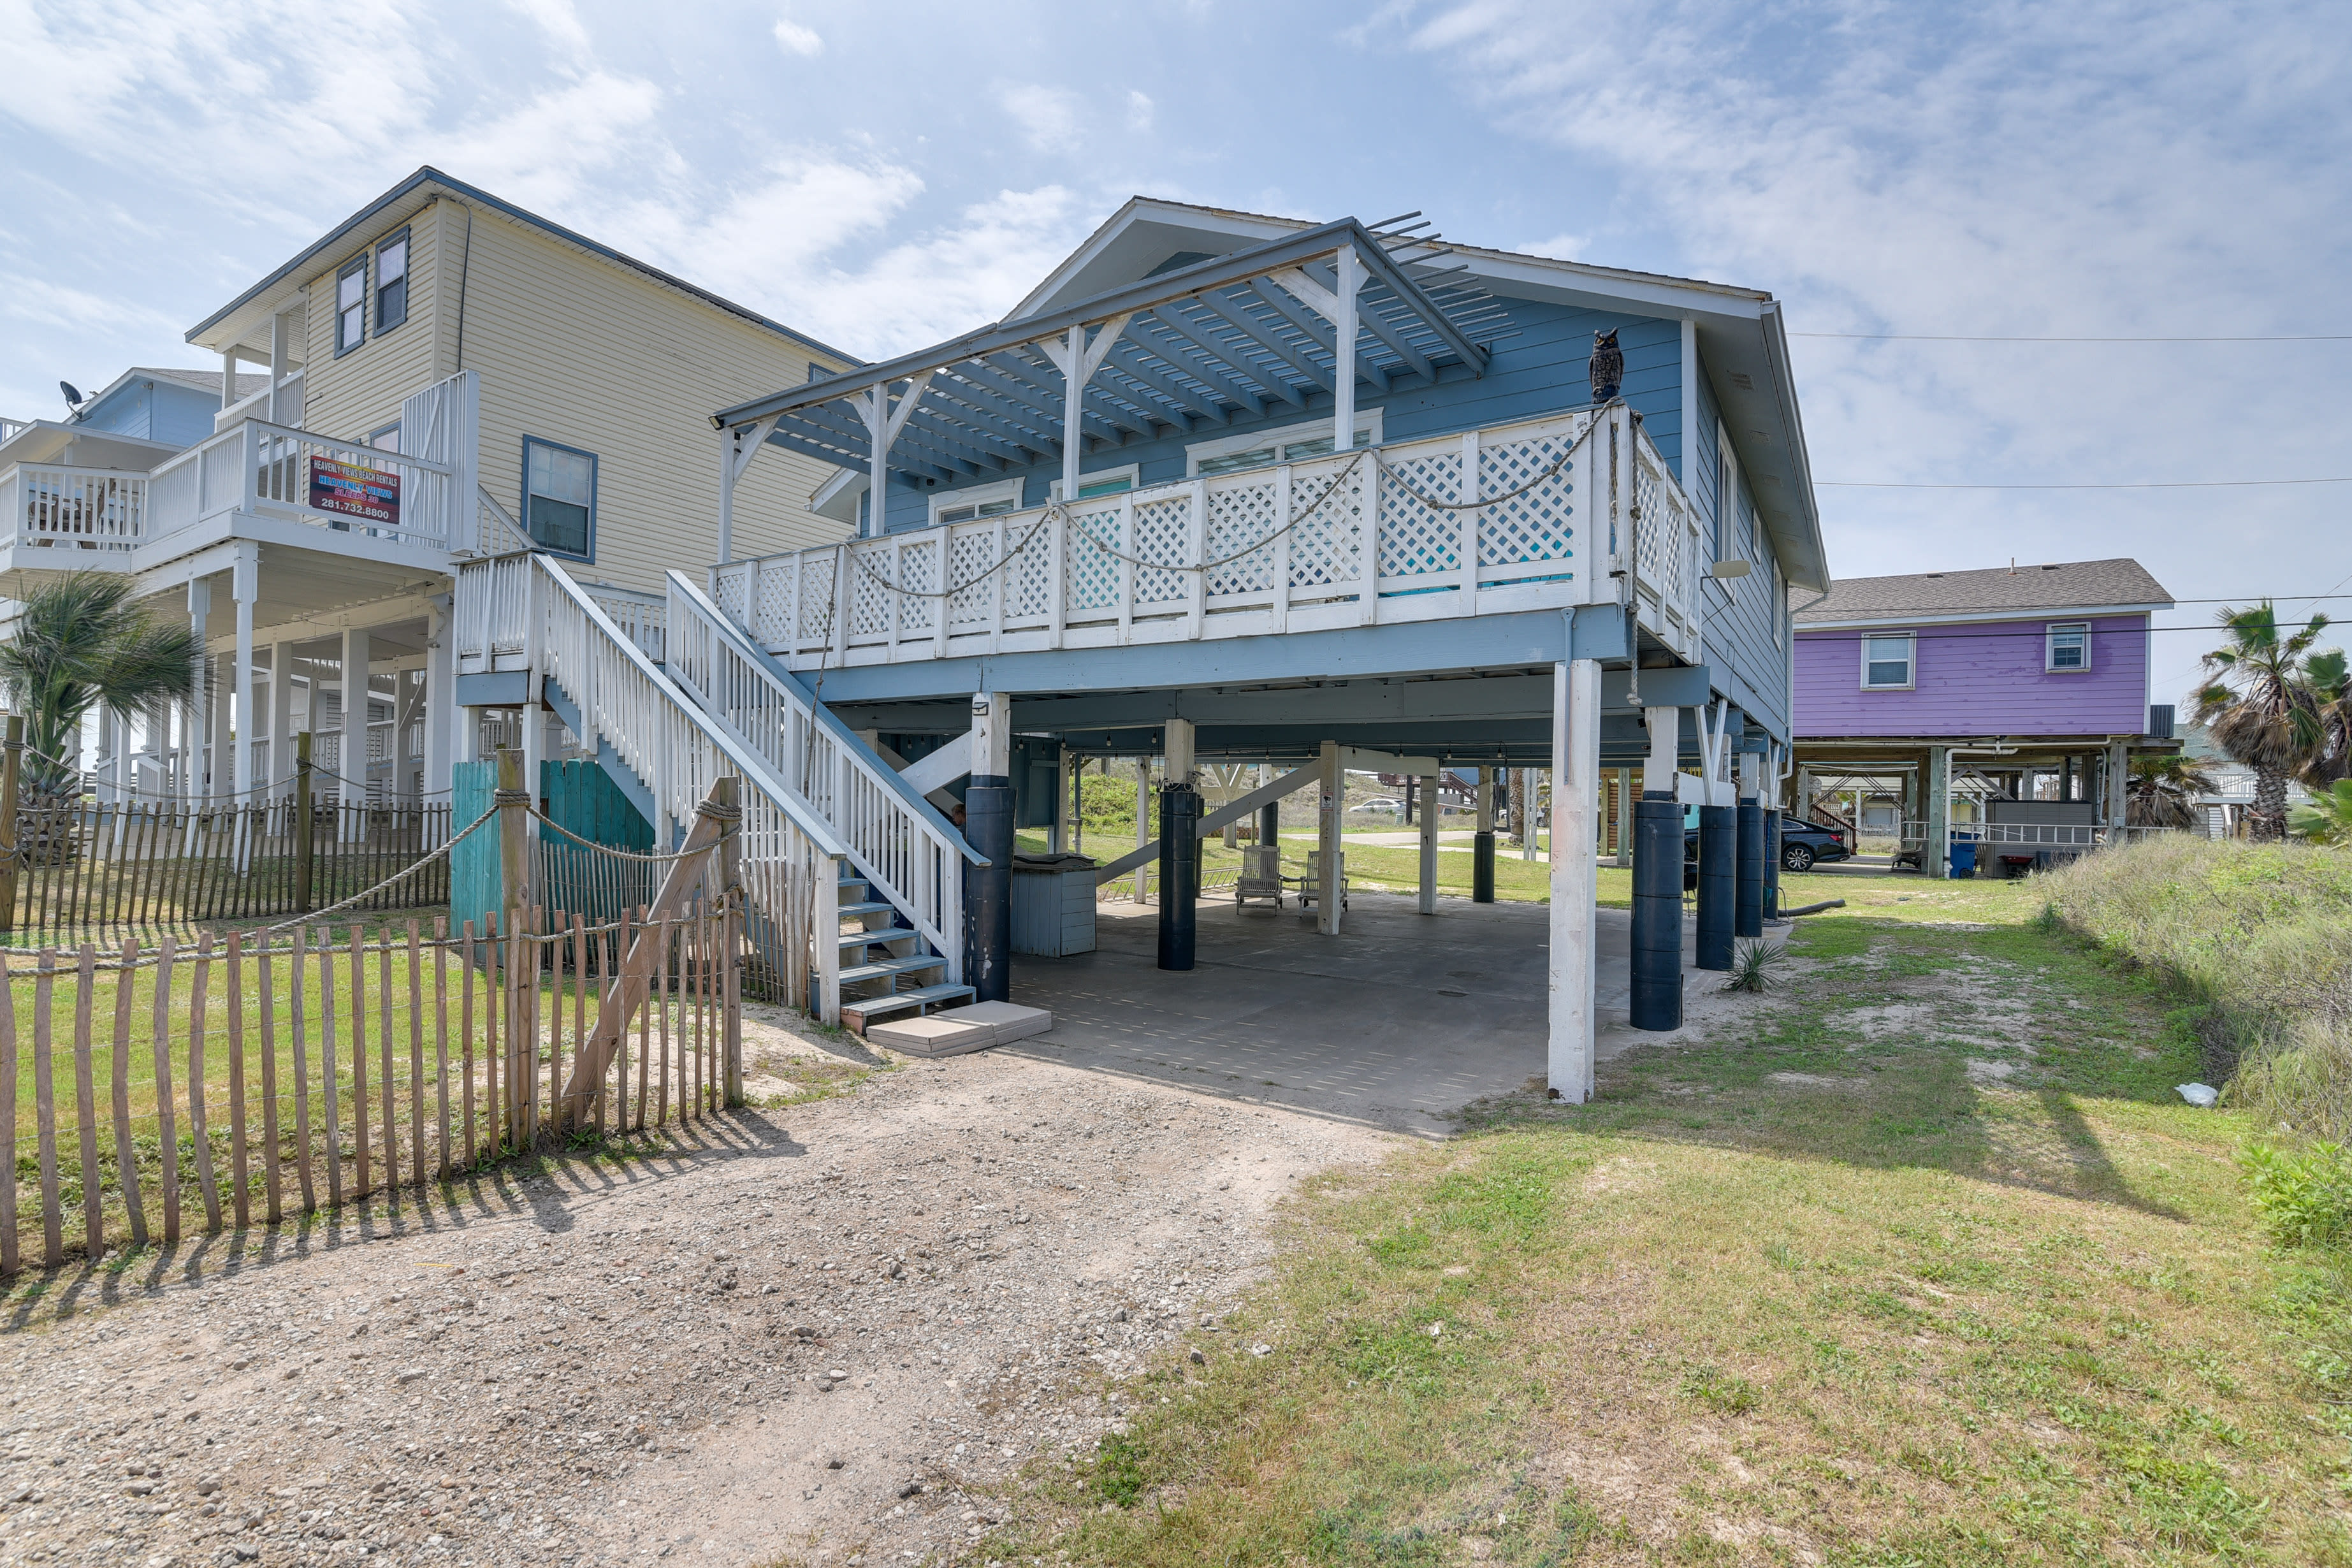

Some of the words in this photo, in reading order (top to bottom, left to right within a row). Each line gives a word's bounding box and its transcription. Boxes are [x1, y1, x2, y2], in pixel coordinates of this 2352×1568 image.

[314, 460, 342, 474] HEAVENLY
[342, 466, 358, 477] VIEWS
[359, 470, 375, 481] BEACH
[376, 474, 397, 487] RENTALS
[319, 475, 364, 491] HEAVENLY
[366, 485, 393, 498] VIEWS
[335, 488, 367, 501] SLEEPS
[321, 498, 389, 519] 281.732.8800
